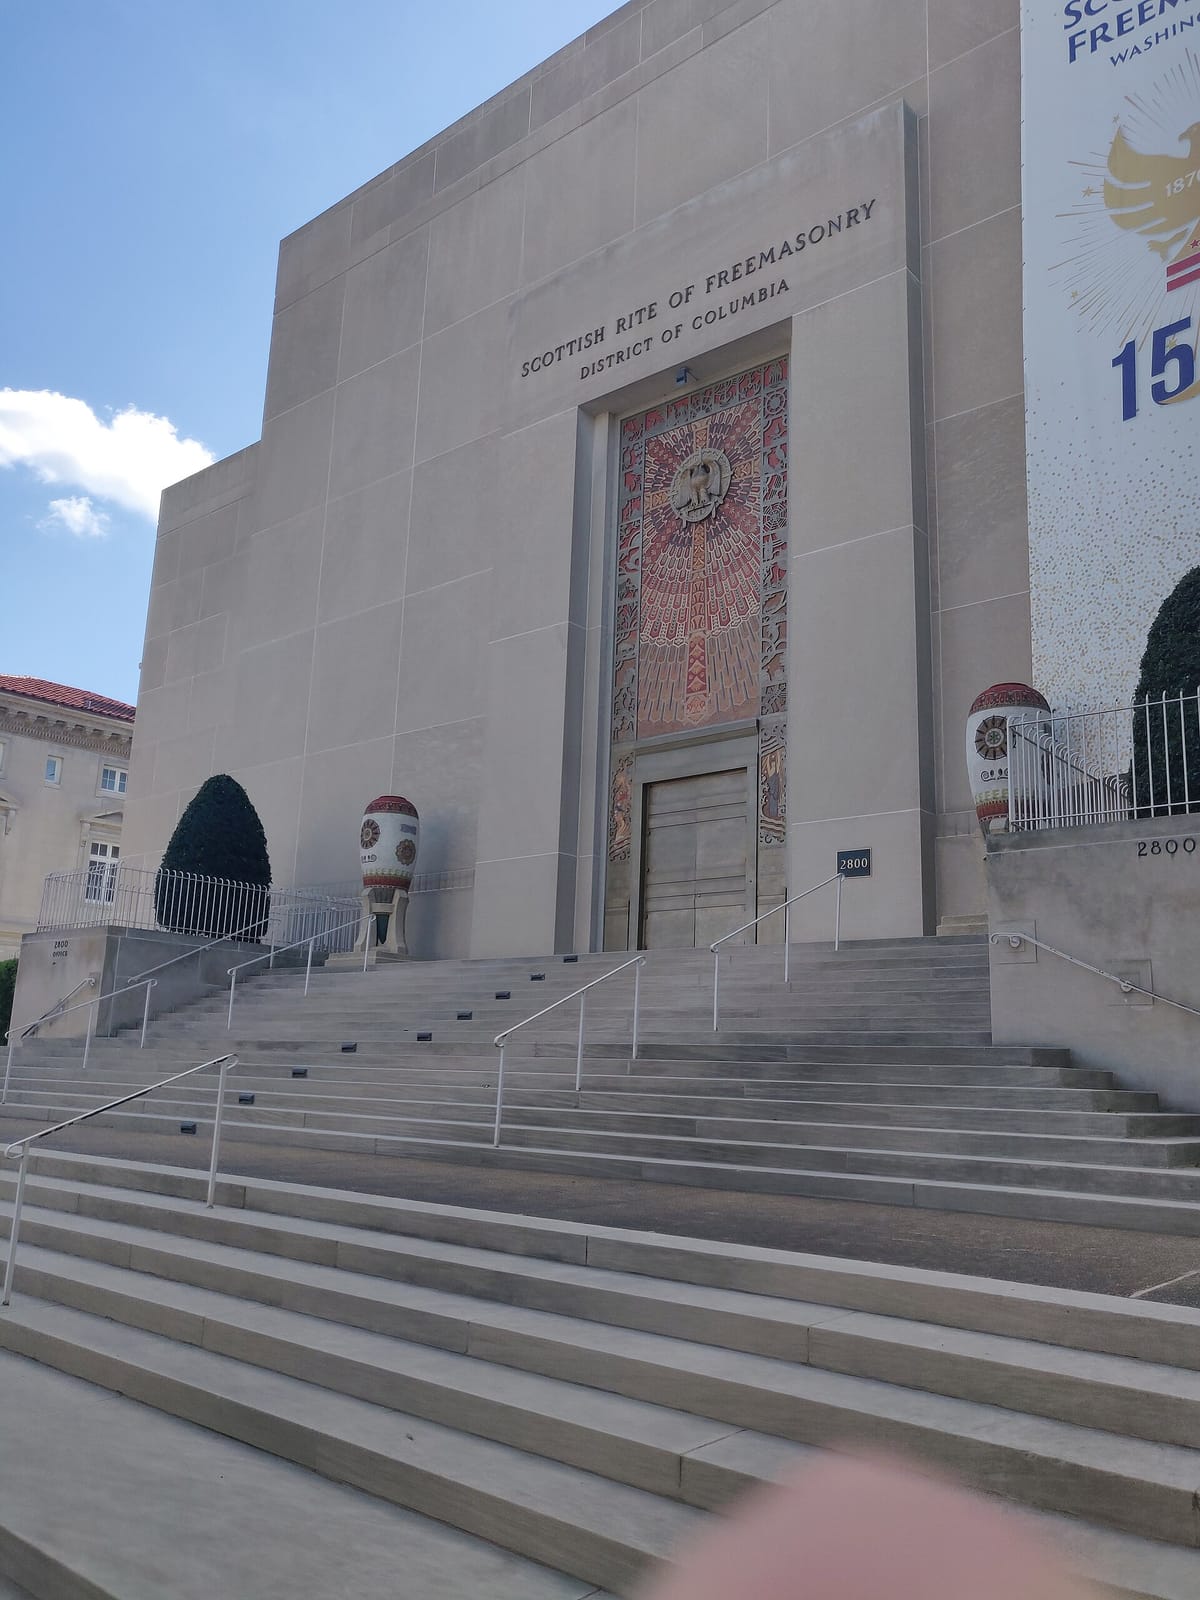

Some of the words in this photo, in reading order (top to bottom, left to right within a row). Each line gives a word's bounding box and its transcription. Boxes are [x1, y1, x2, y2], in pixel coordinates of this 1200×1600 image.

[1165, 170, 1200, 197] 187
[521, 326, 605, 378] SCOTTISH
[615, 302, 658, 335] RITE
[668, 285, 695, 309] OF
[705, 198, 876, 294] FREEMASONRY
[580, 337, 653, 380] DISTRICT
[661, 324, 683, 344] OF
[692, 278, 790, 330] COLUMBIA
[1137, 838, 1196, 857] 2800
[840, 857, 868, 870] 2800
